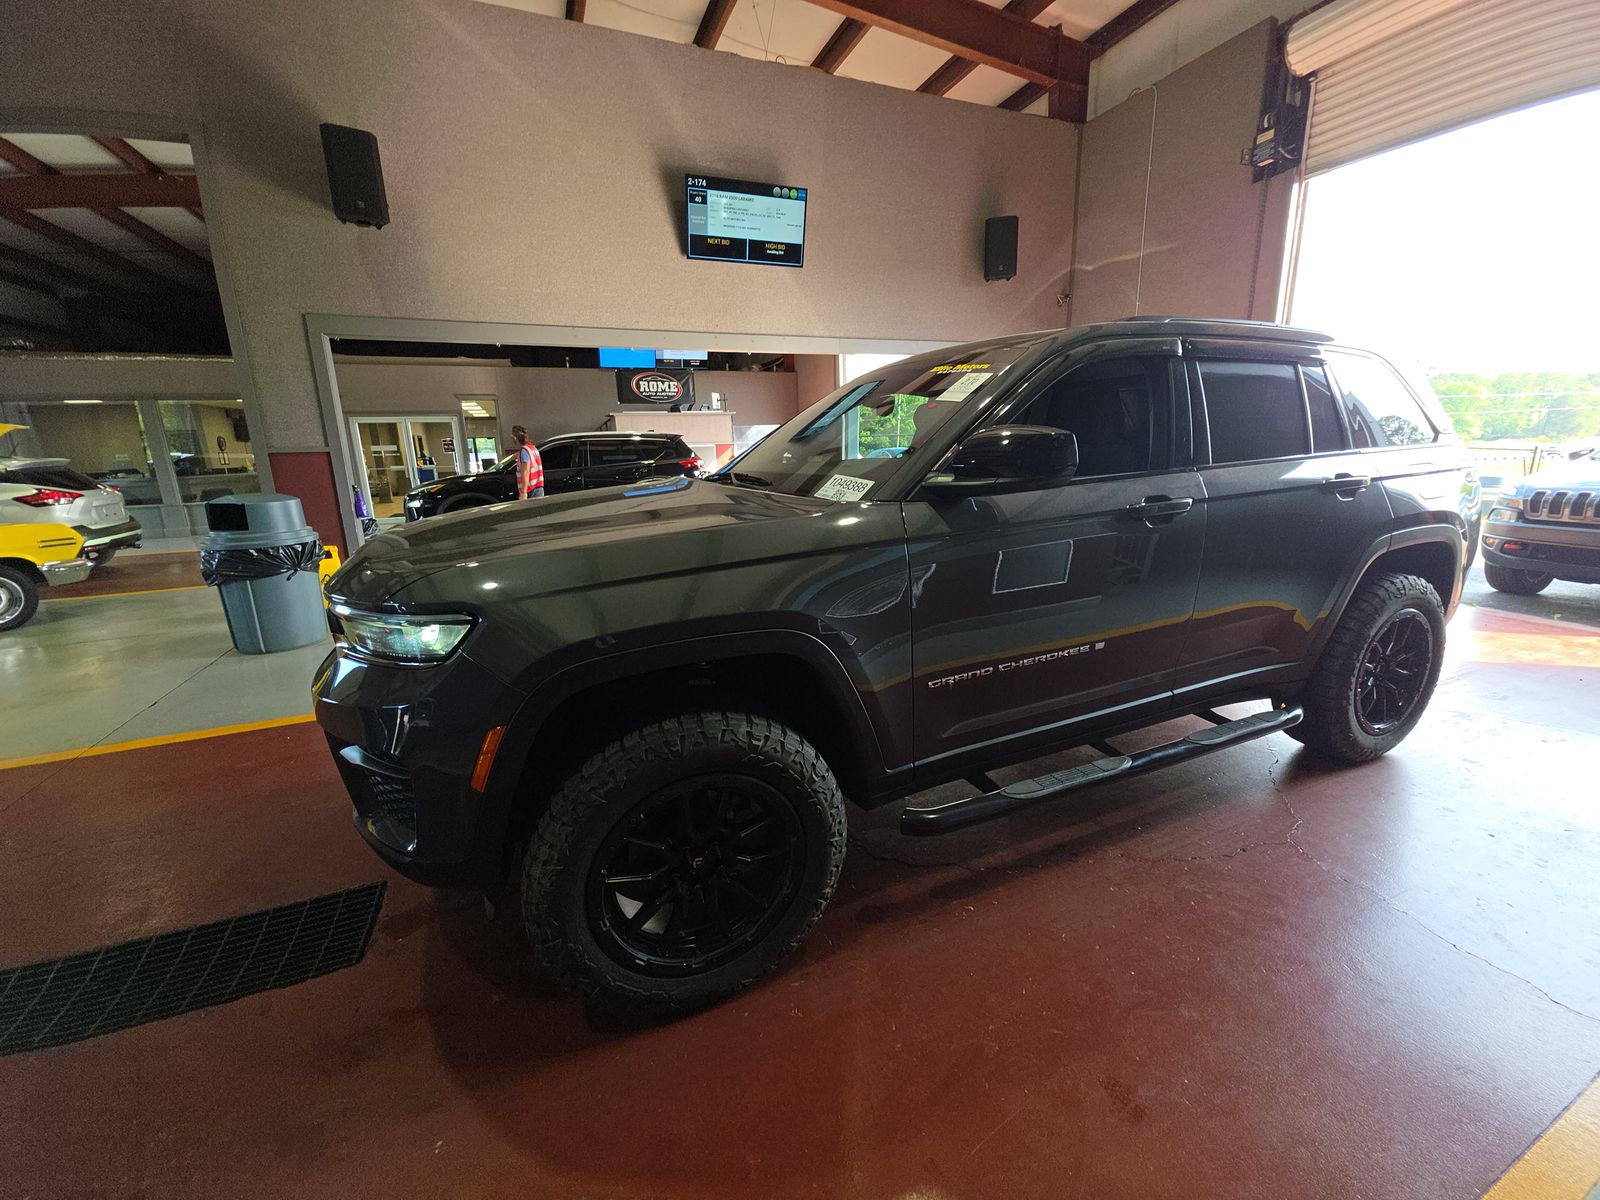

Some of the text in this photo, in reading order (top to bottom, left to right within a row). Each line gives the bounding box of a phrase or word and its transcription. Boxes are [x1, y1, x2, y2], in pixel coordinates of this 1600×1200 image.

[687, 177, 707, 187] 2-174
[639, 381, 678, 392] ROME
[829, 477, 869, 493] 1049388
[928, 644, 1091, 689] GRAND CHEROKEE
